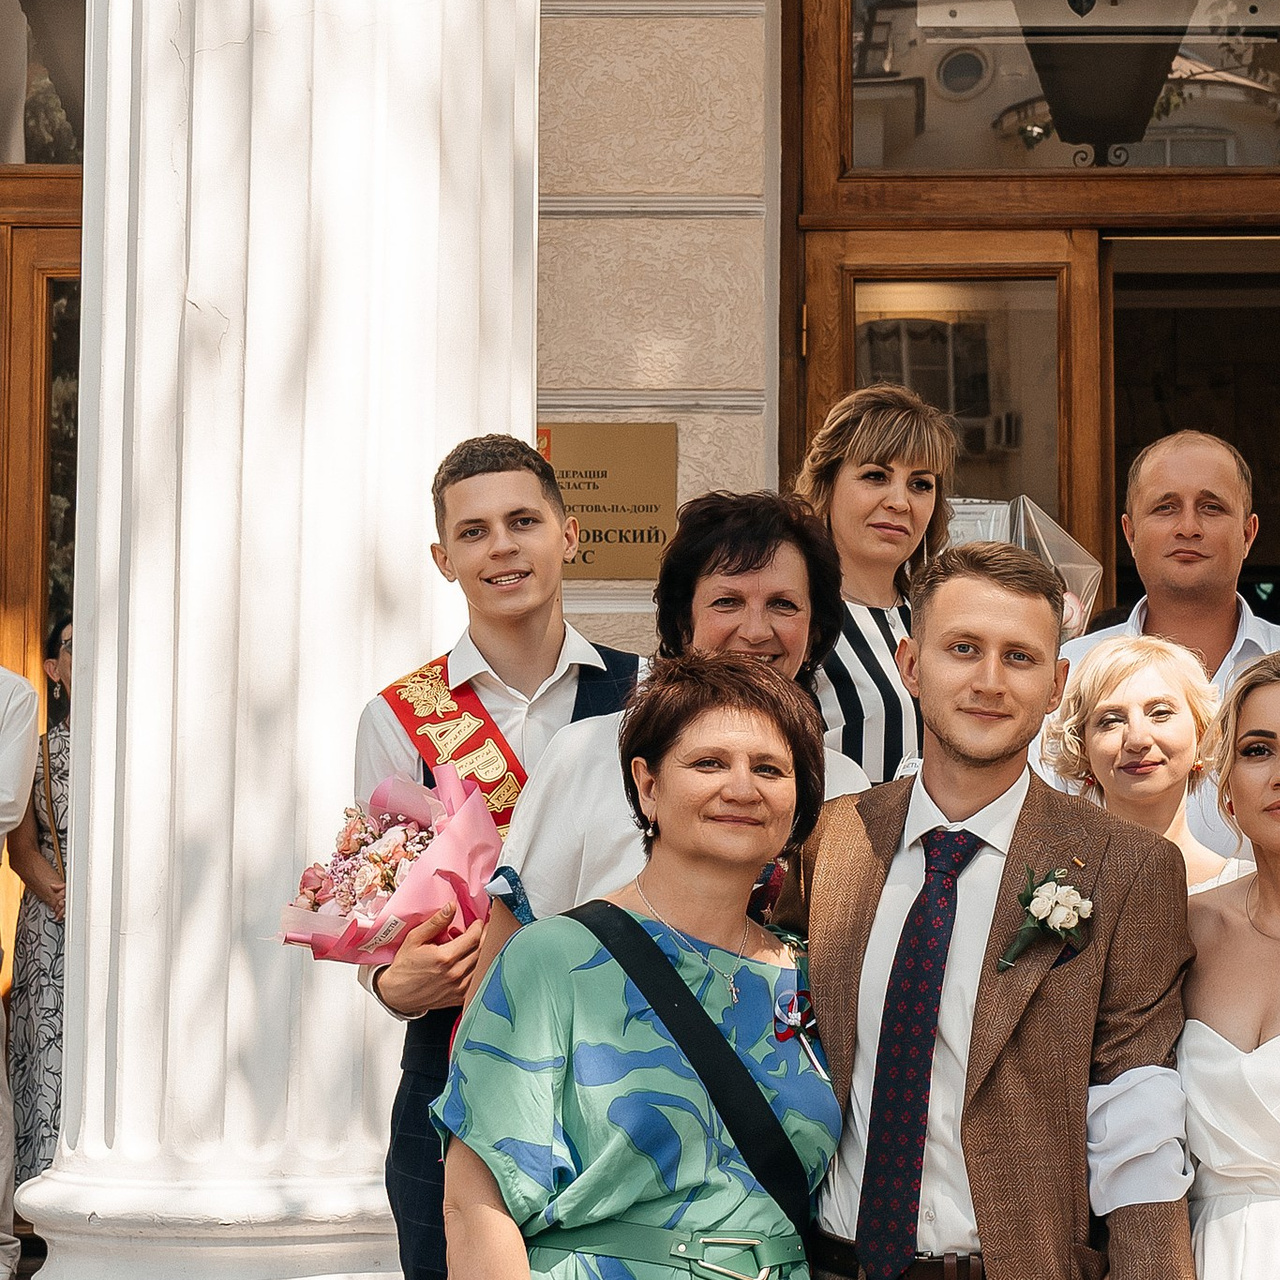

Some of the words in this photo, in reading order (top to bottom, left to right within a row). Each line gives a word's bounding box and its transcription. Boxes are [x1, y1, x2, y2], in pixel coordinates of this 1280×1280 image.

[555, 470, 608, 479] ДЕРАЦИЯ
[558, 481, 600, 490] БЛАСТЬ
[564, 504, 661, 514] ОСТОВА-НА-ДОНУ
[578, 526, 667, 546] ОВСКИЙ)
[416, 711, 522, 841] ДРУ
